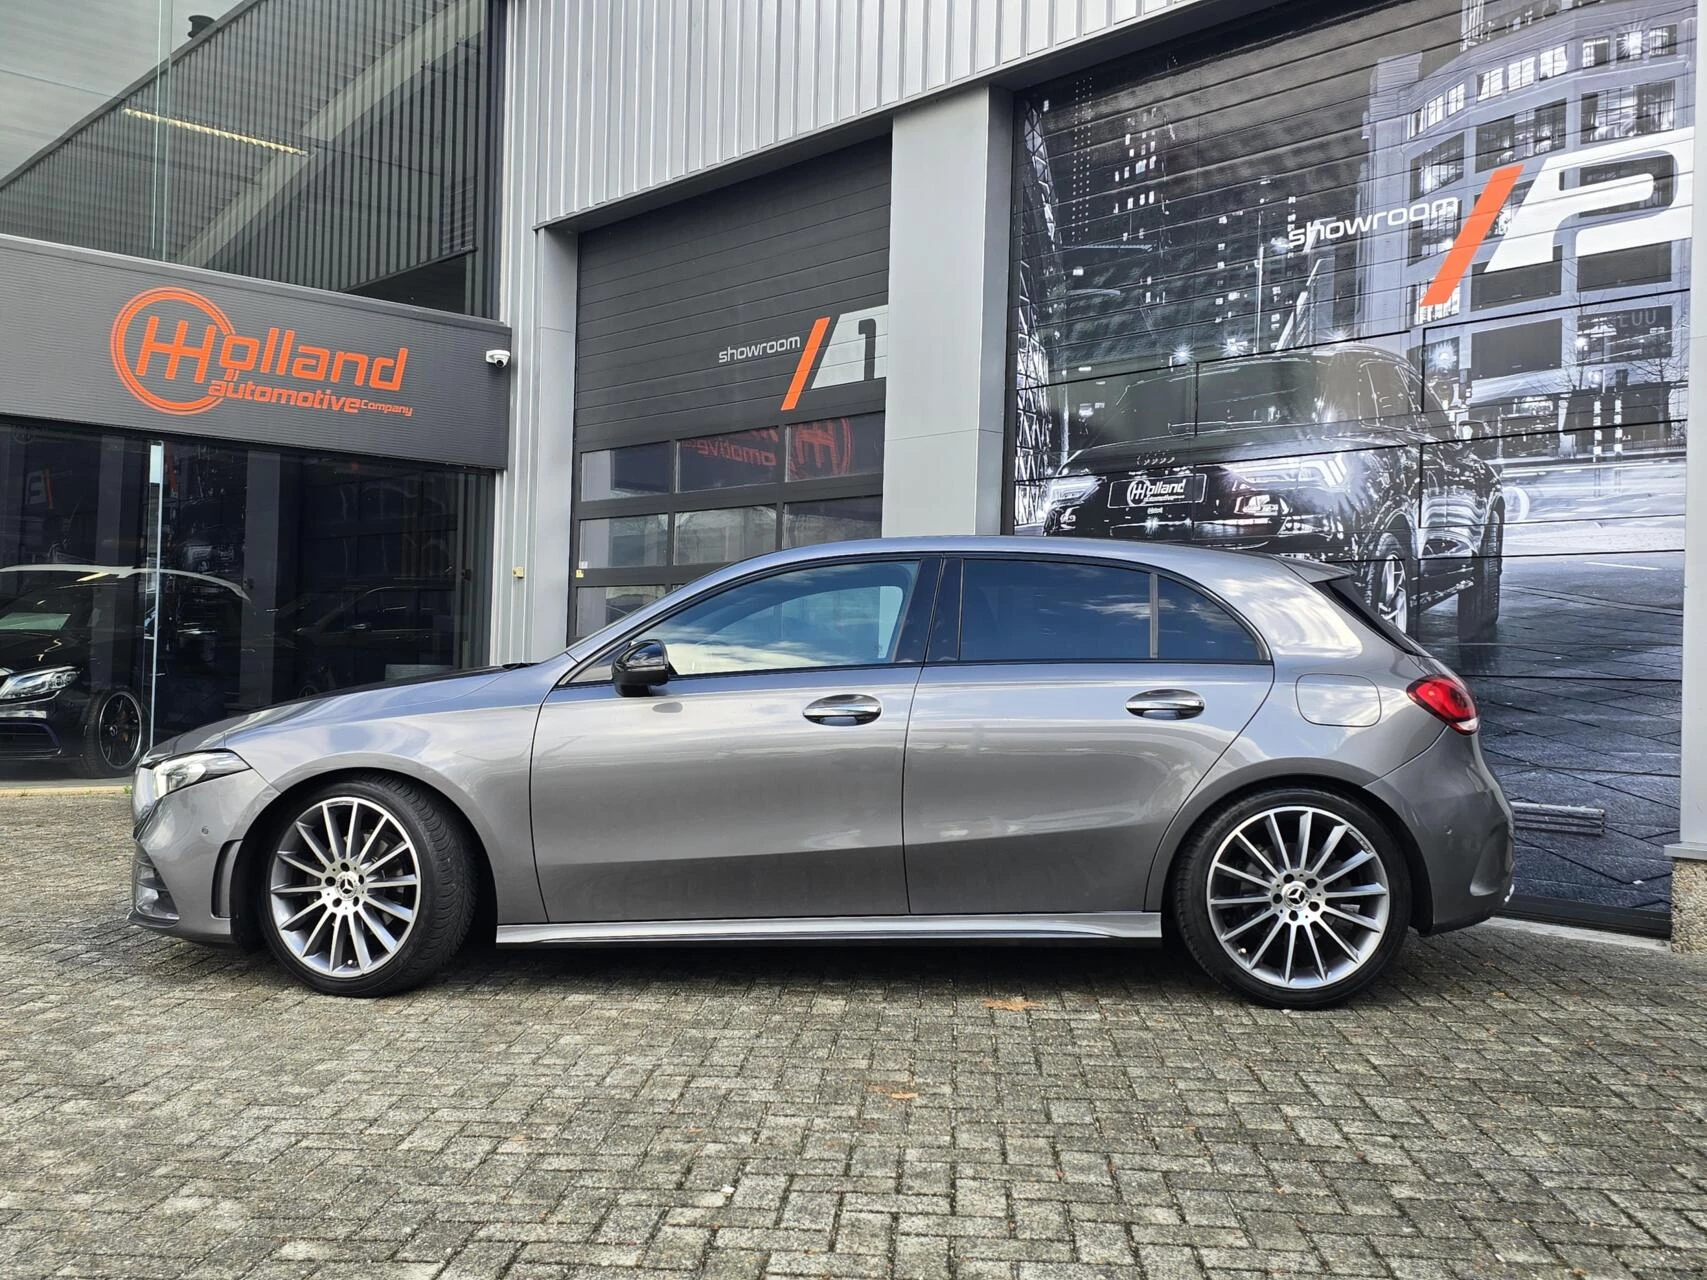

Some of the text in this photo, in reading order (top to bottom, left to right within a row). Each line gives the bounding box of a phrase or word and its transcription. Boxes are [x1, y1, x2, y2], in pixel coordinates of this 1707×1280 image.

[1287, 196, 1459, 248] showroom
[135, 315, 409, 391] Holland
[718, 336, 801, 364] showroom
[207, 379, 413, 416] automotive Company
[1130, 478, 1187, 500] Holland
